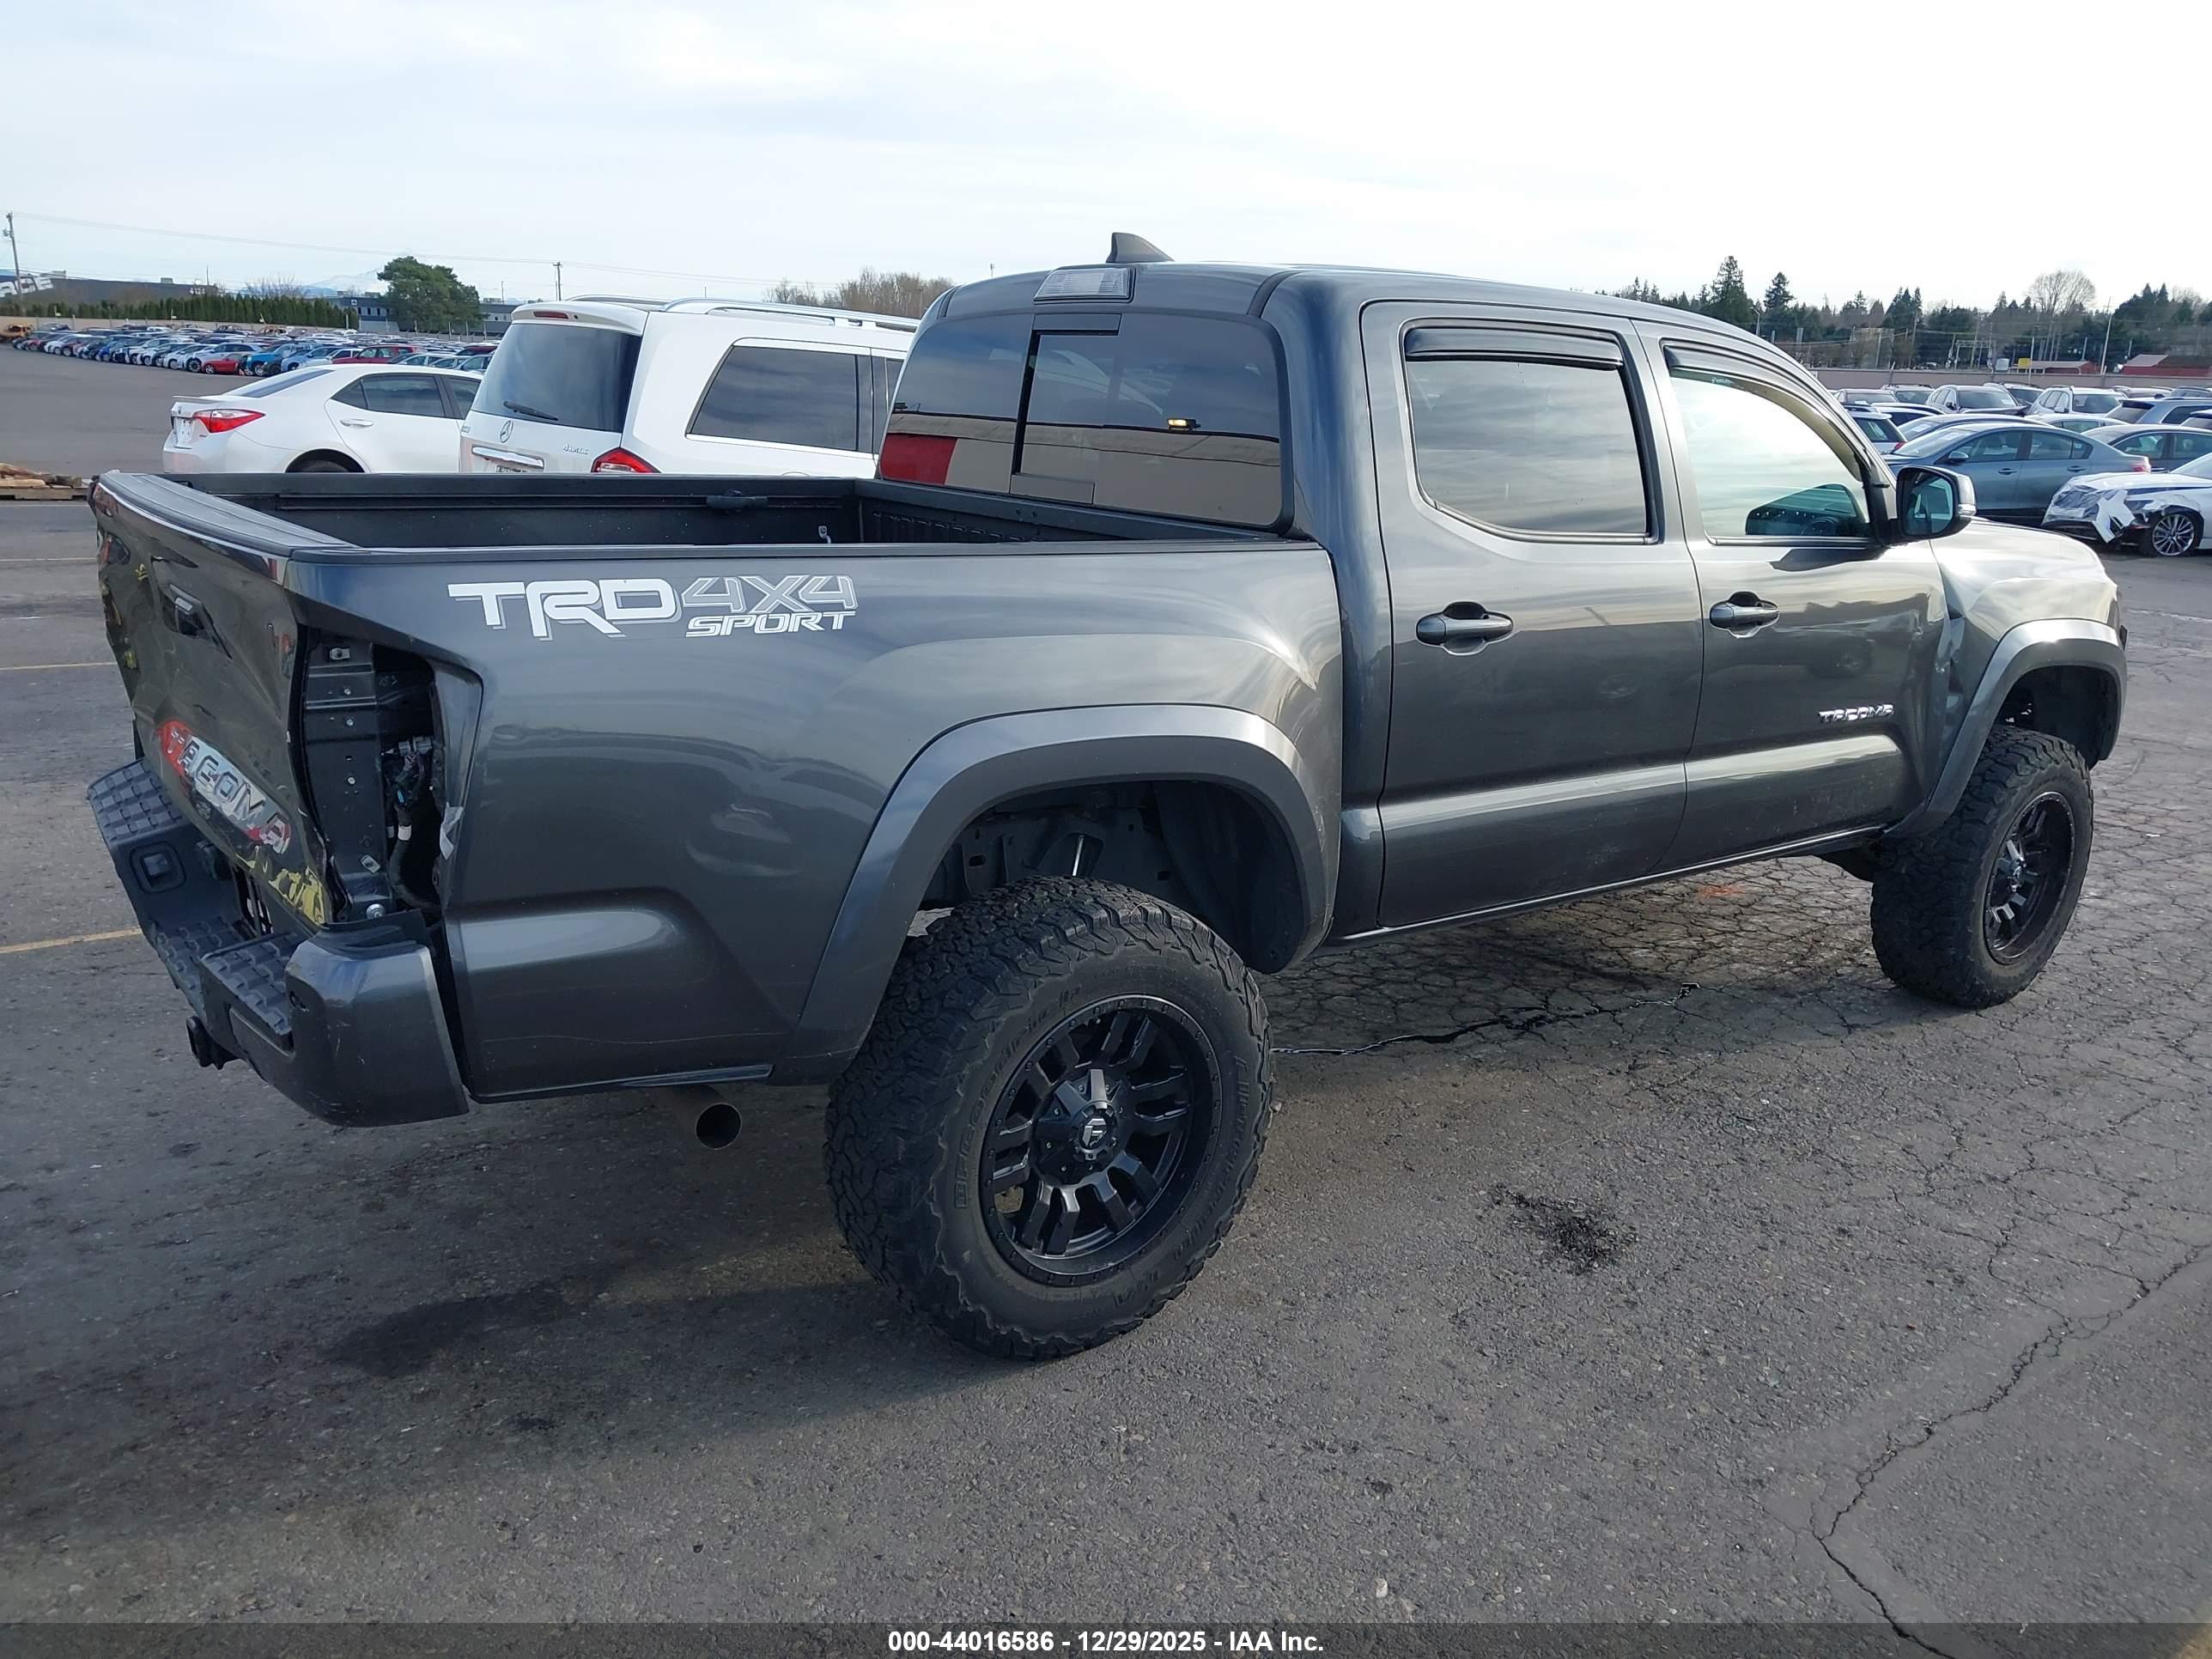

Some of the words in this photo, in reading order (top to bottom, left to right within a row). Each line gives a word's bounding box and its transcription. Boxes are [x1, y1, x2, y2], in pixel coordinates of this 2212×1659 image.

[447, 578, 681, 641] TRD
[681, 574, 858, 613] 4X4
[686, 611, 856, 637] SPORT
